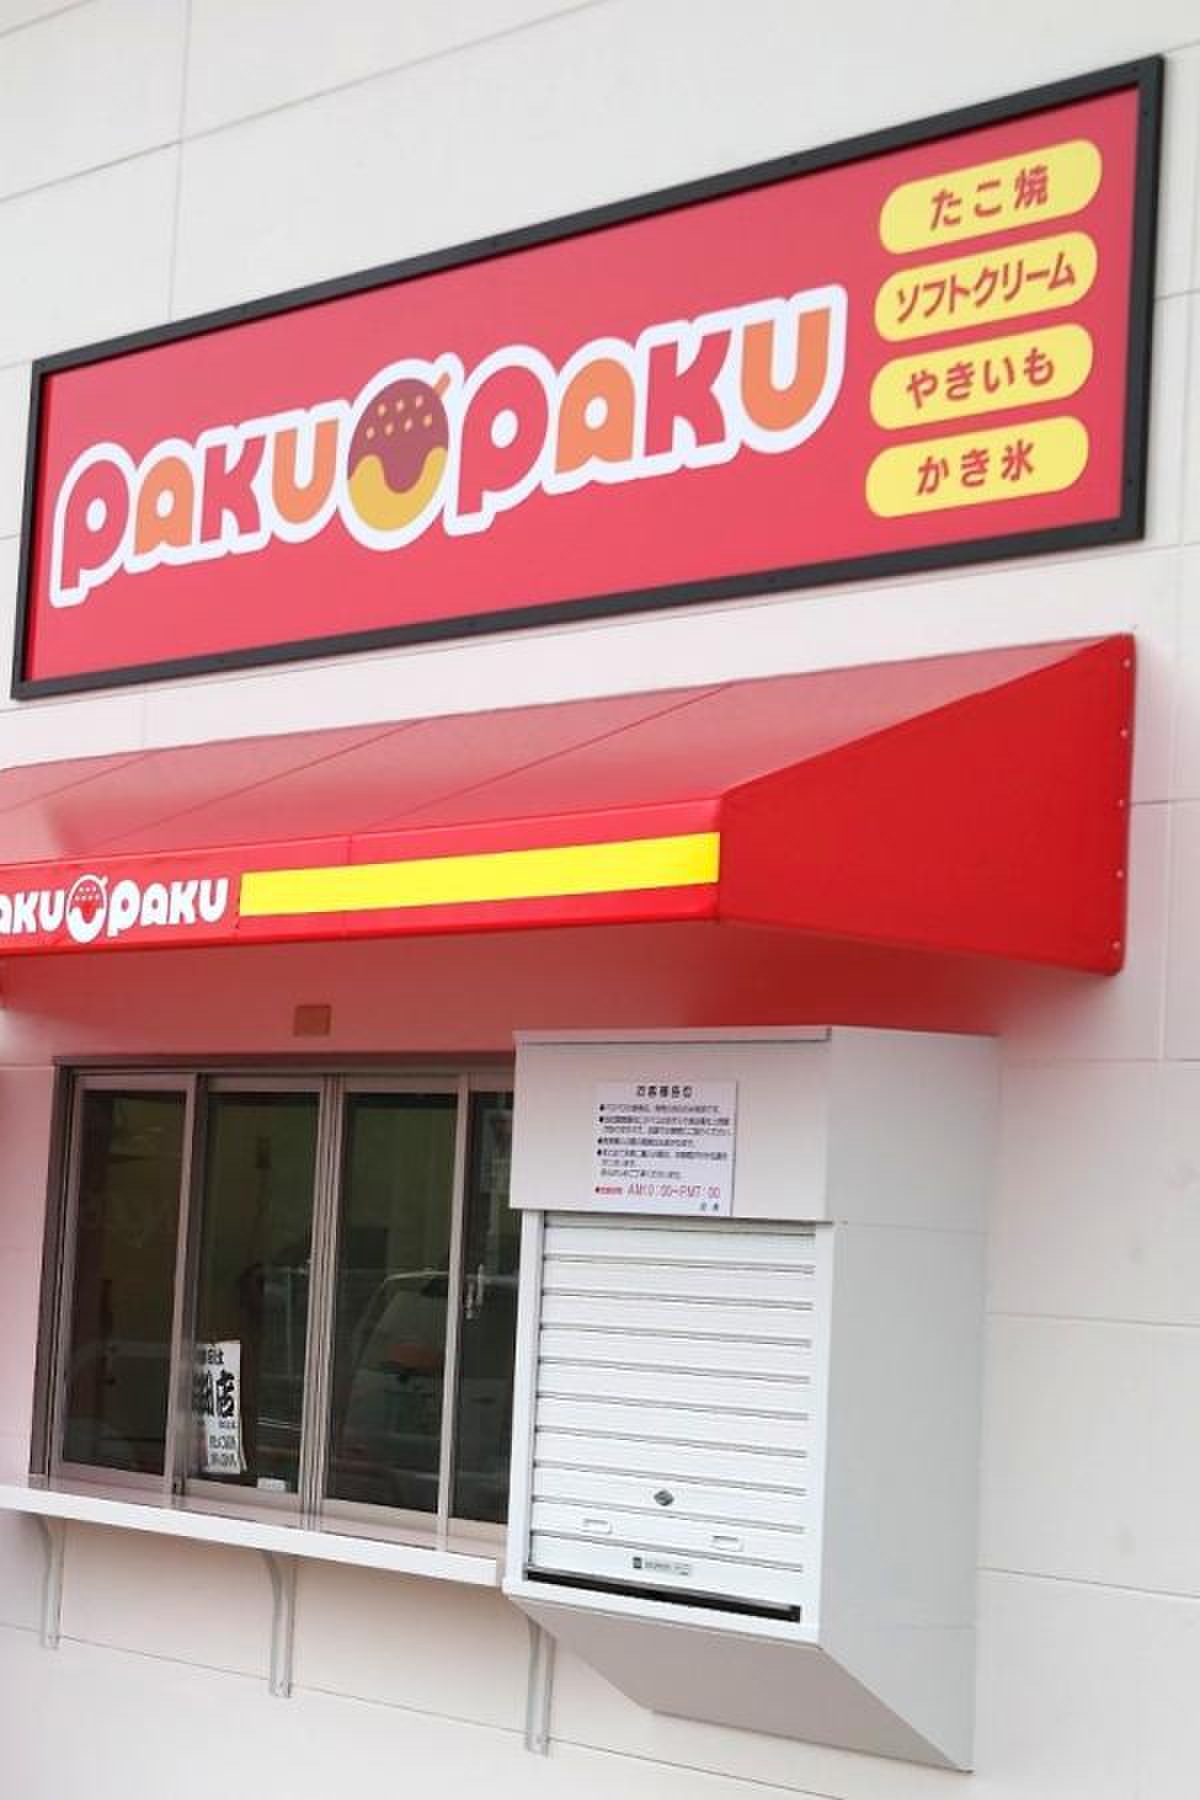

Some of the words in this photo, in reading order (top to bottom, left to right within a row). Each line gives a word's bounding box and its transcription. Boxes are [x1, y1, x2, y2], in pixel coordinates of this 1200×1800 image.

[930, 164, 1049, 231] たこ焼
[897, 252, 1076, 324] ソフトクリーム
[907, 347, 1055, 409] やきいも
[916, 440, 1035, 496] かき氷
